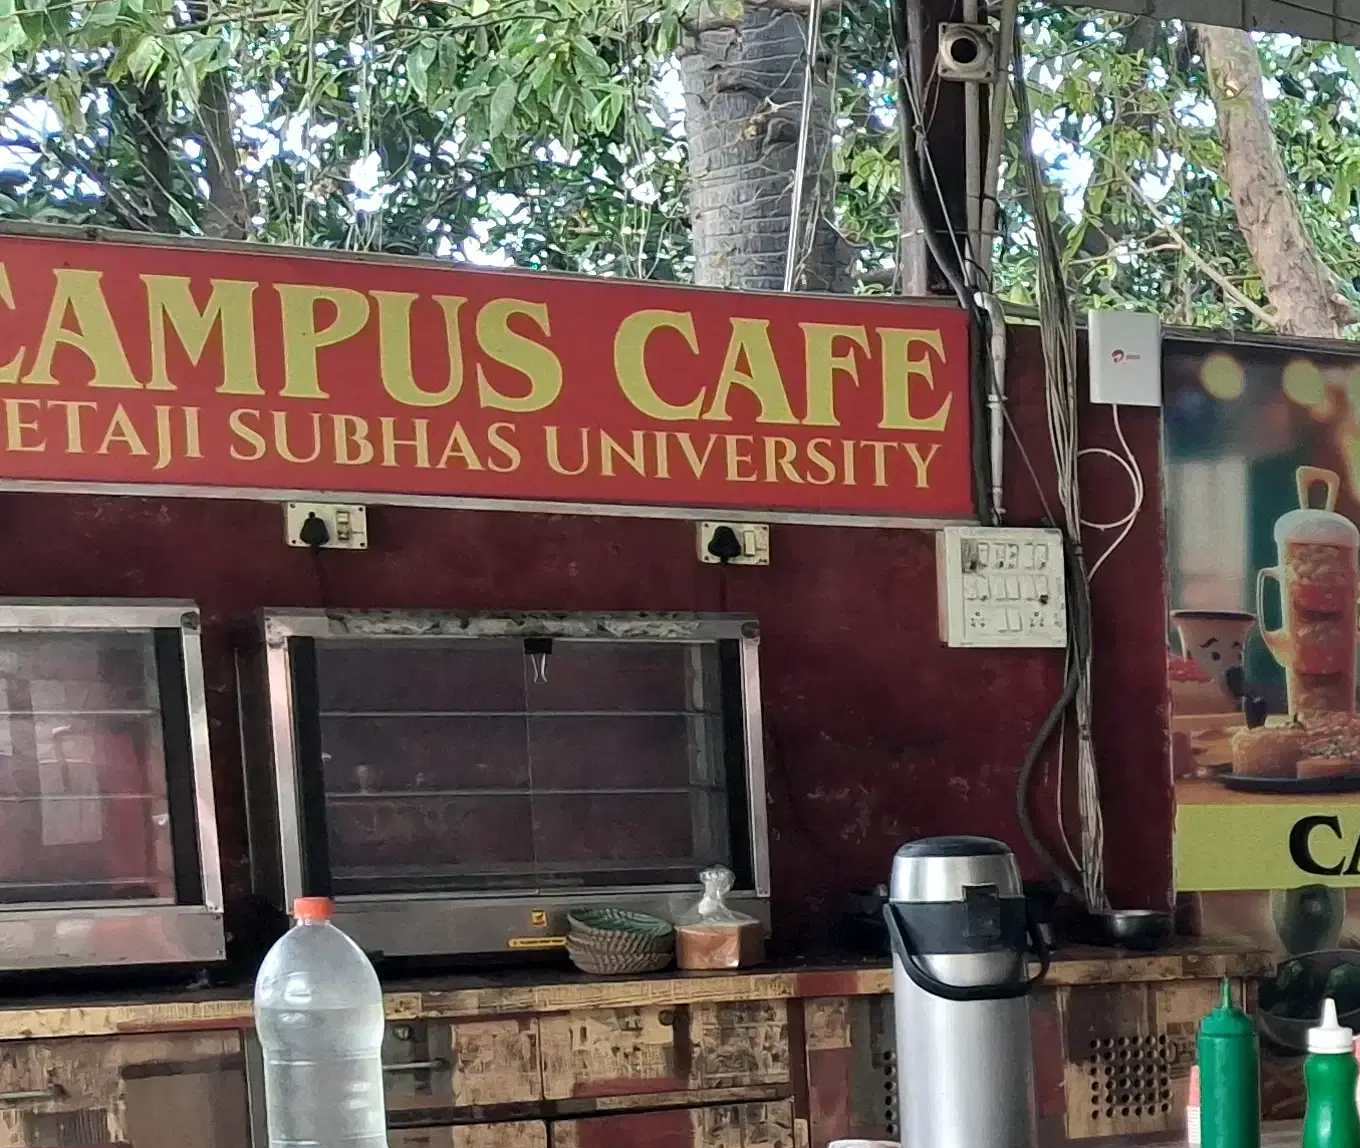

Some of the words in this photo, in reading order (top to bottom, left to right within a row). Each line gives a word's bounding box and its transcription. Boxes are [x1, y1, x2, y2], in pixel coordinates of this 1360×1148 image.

[613, 308, 952, 433] CAFE
[0, 397, 205, 470] ETAJI
[229, 408, 521, 474] SUBHAS
[544, 425, 943, 490] UNIVERSITY
